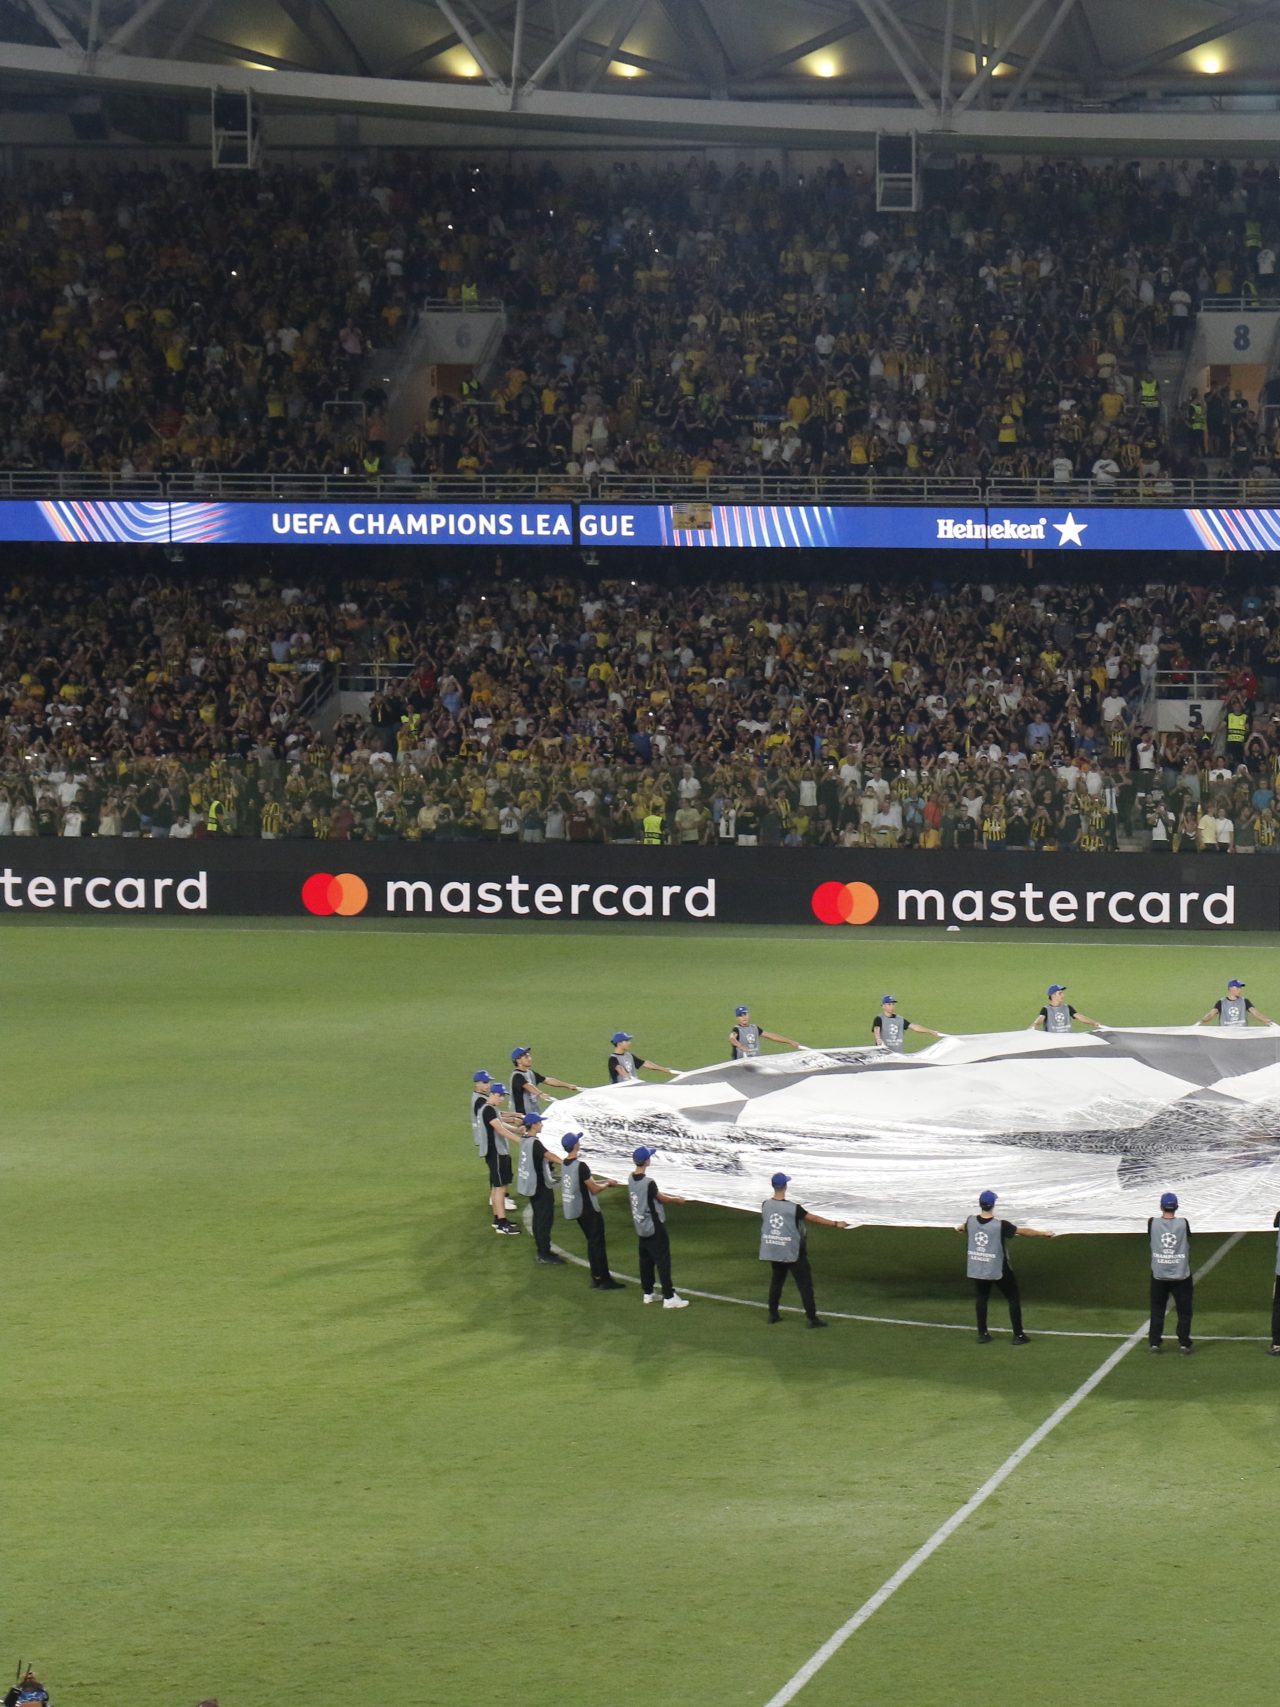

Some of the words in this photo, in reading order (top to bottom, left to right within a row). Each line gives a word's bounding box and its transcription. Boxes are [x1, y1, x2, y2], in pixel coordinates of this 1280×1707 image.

[455, 322, 472, 349] 6
[1233, 324, 1250, 351] 8
[272, 512, 342, 535] UEFA
[348, 513, 514, 536] CHAMPIONS
[936, 518, 1046, 540] Heineken
[1188, 704, 1202, 727] 5
[0, 868, 208, 910] tercard
[385, 874, 716, 918] mastercard
[897, 882, 1235, 925] mastercard
